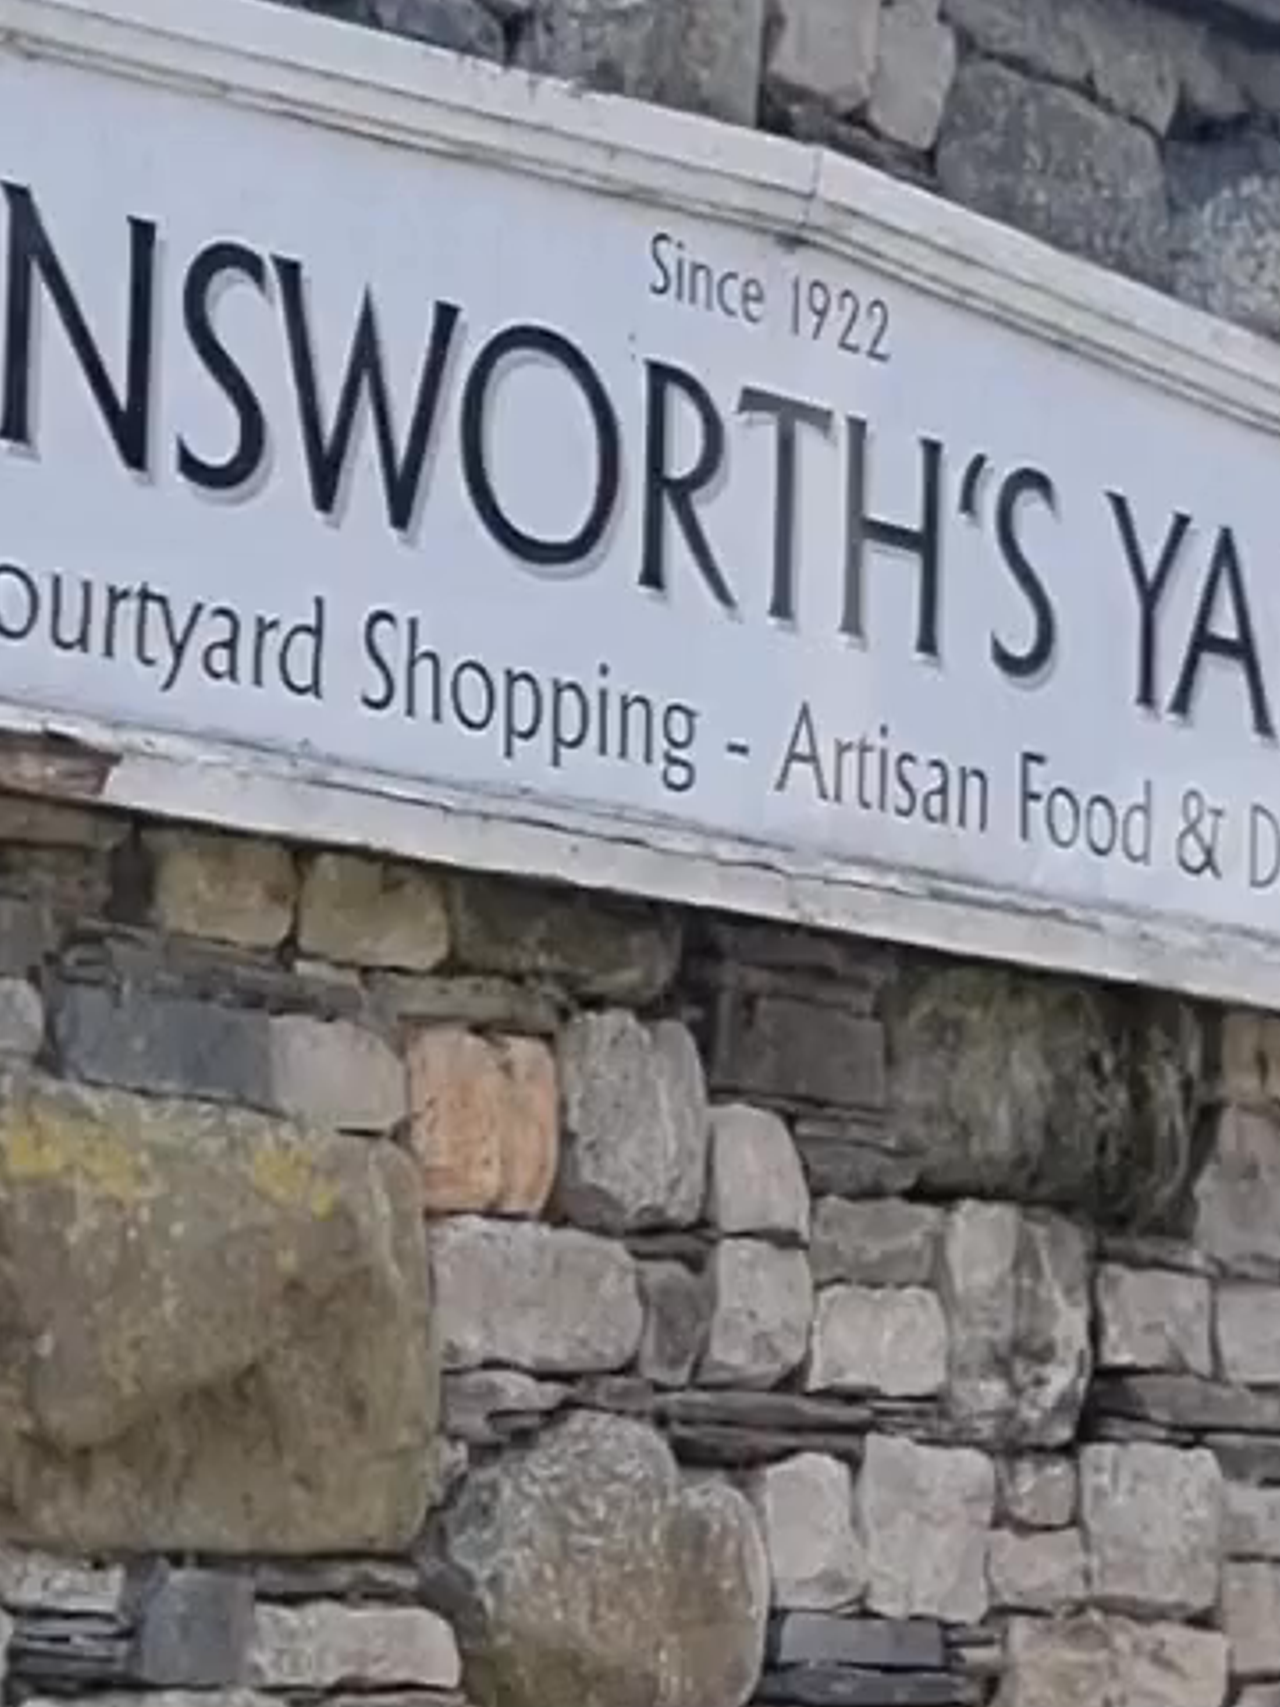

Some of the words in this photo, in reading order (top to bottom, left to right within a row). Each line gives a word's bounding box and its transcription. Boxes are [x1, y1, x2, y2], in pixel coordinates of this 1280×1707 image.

[649, 232, 766, 323] Since
[790, 275, 893, 363] 1922
[359, 609, 700, 793] Shopping
[774, 701, 989, 835] Artisan
[1019, 750, 1154, 869] Food
[1175, 787, 1228, 880] &
